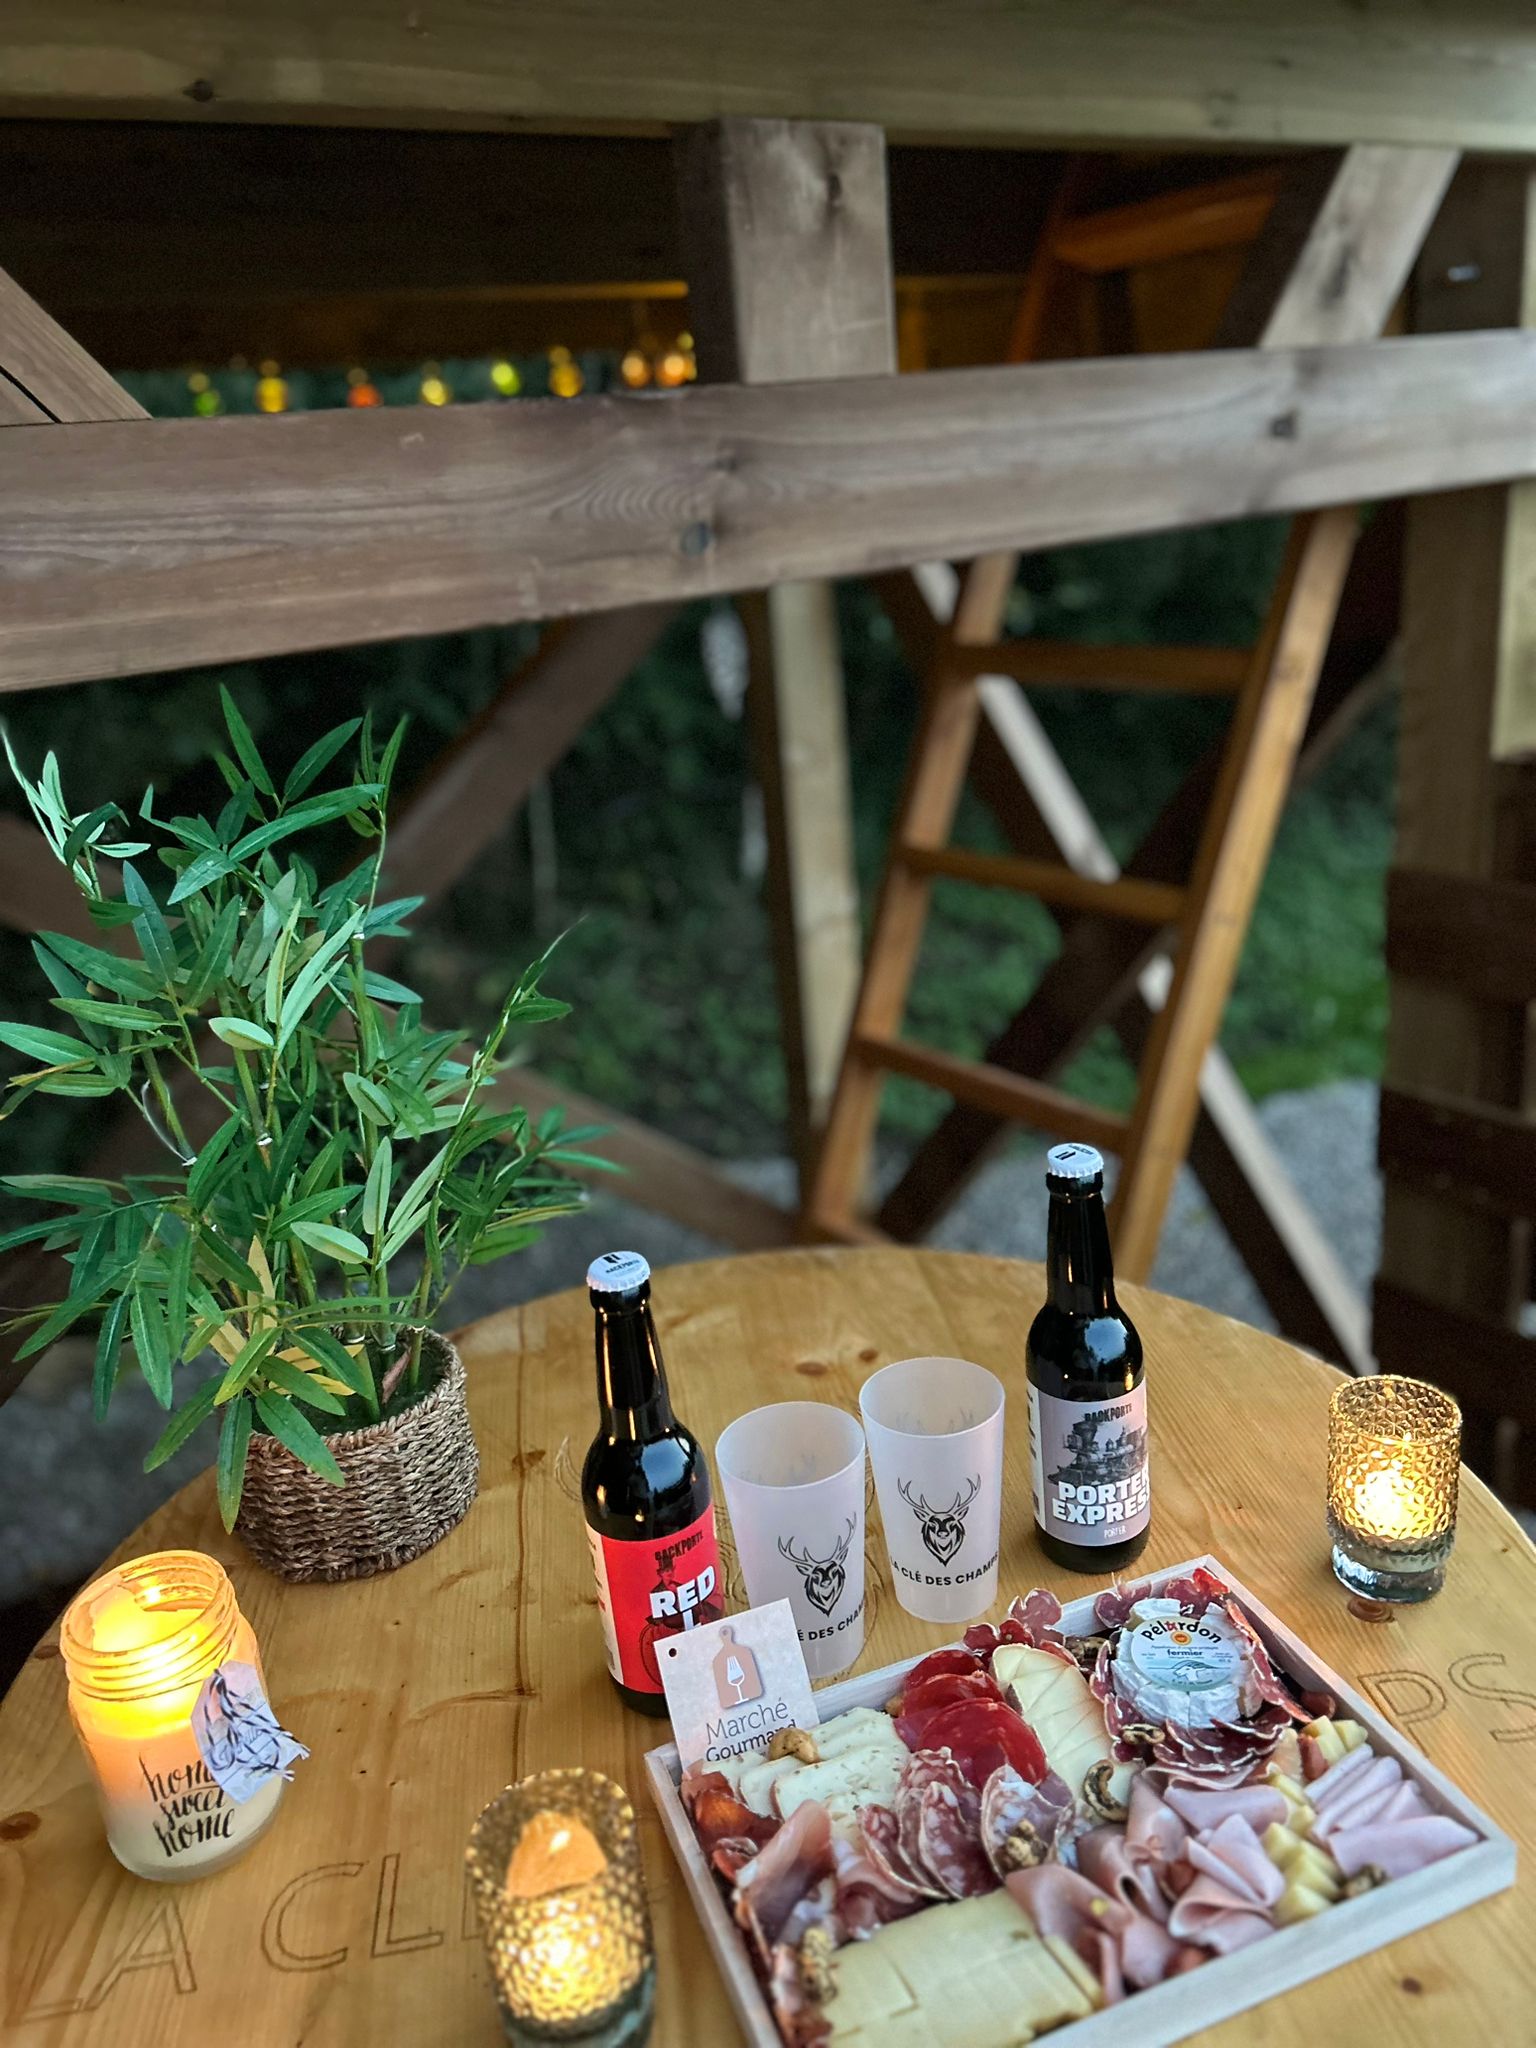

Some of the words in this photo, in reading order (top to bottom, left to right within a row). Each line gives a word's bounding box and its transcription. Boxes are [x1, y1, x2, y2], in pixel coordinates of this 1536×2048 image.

[1052, 1487, 1150, 1525] EXPRES
[1103, 1525, 1128, 1540] PORTER
[649, 1565, 716, 1620] RED
[901, 1567, 922, 1583] CLÉ
[925, 1575, 952, 1586] DES
[808, 1626, 835, 1641] DES
[1140, 1620, 1222, 1644] Pélardon
[1166, 1648, 1204, 1657] fermier
[706, 1697, 789, 1745] Marché
[138, 1752, 217, 1801] hom
[159, 1788, 225, 1831] sweet
[153, 1808, 235, 1858] home
[260, 1852, 488, 1973] CL
